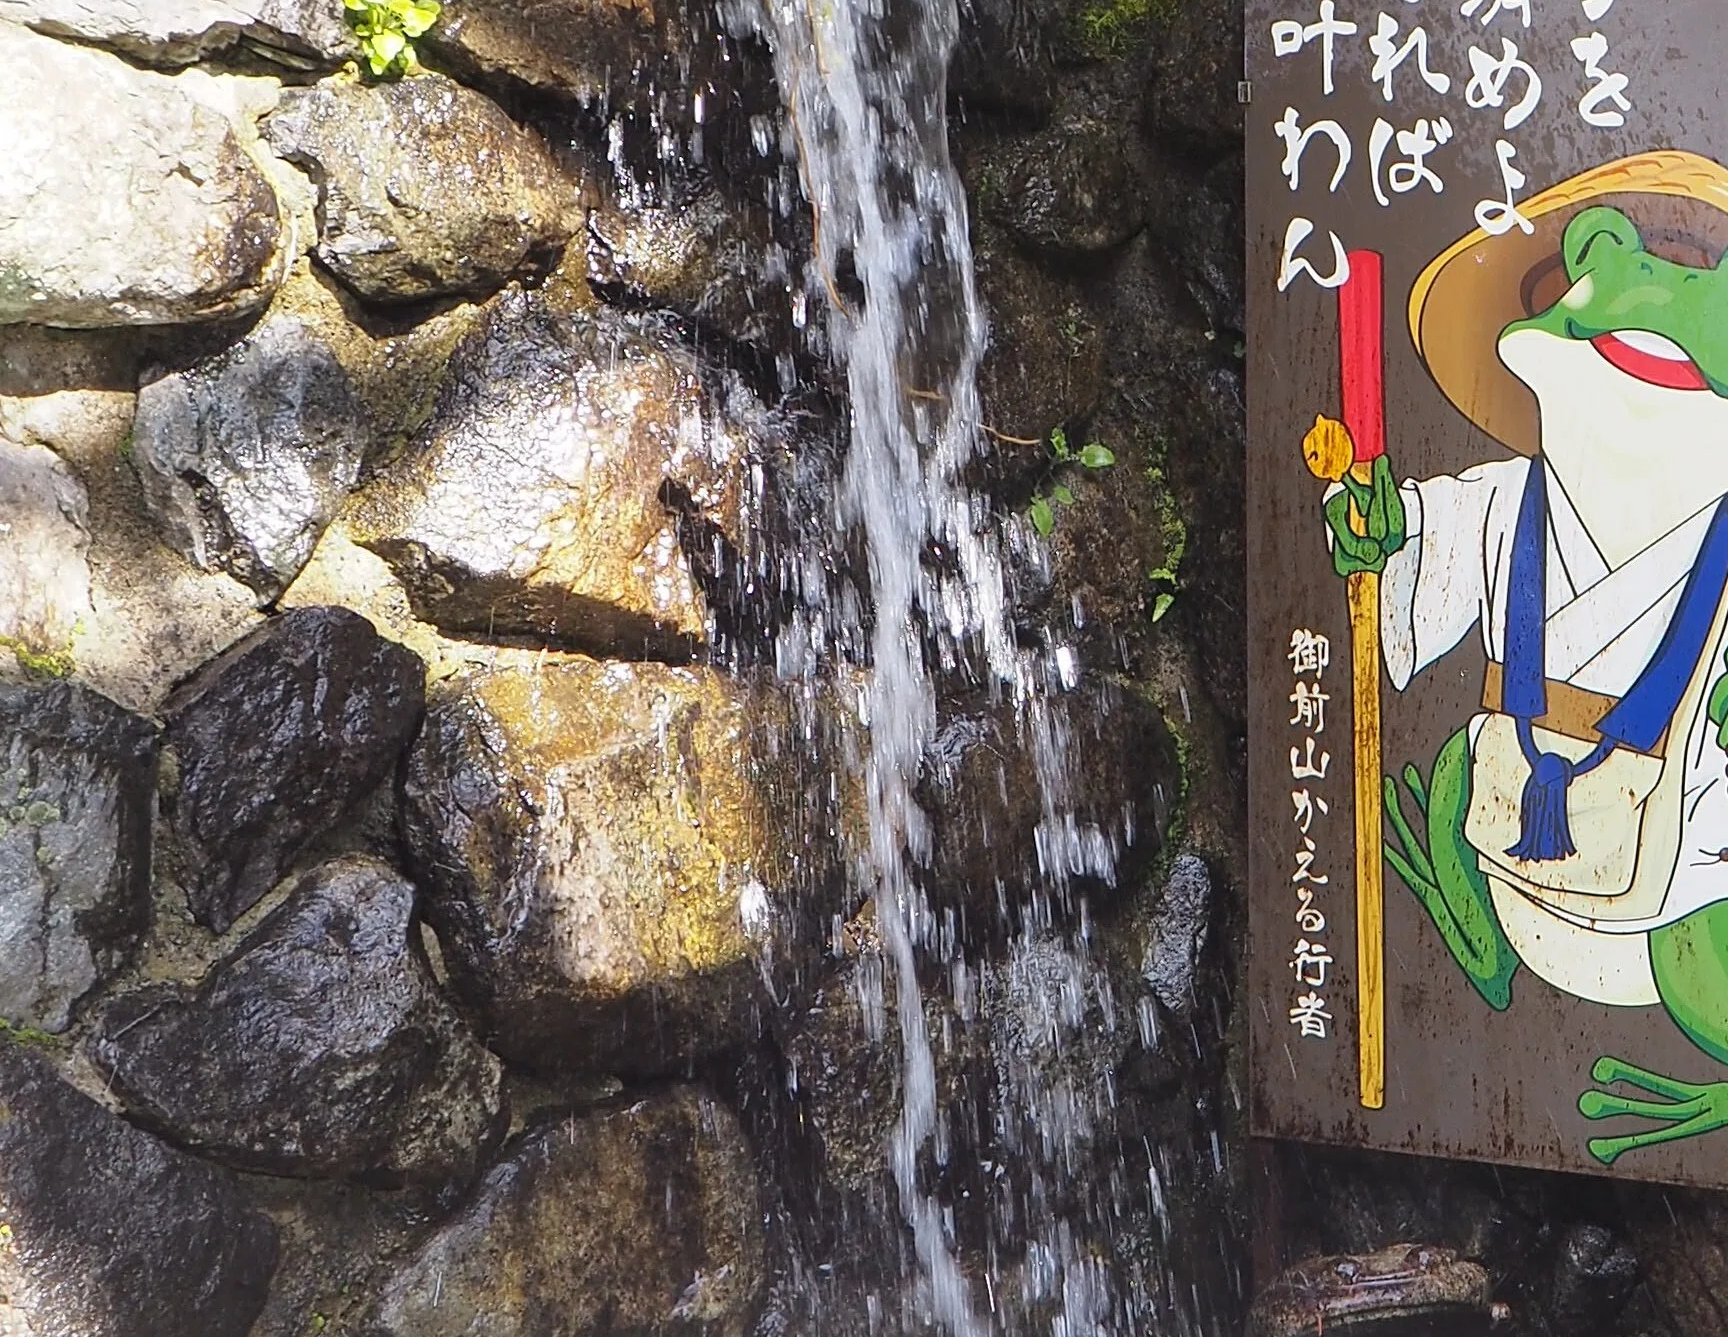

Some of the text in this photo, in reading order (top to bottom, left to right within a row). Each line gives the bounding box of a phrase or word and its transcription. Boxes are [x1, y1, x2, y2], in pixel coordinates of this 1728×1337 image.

[1272, 0, 1358, 292] 叶わん
[1288, 628, 1333, 1038] 御前山かえる行者
